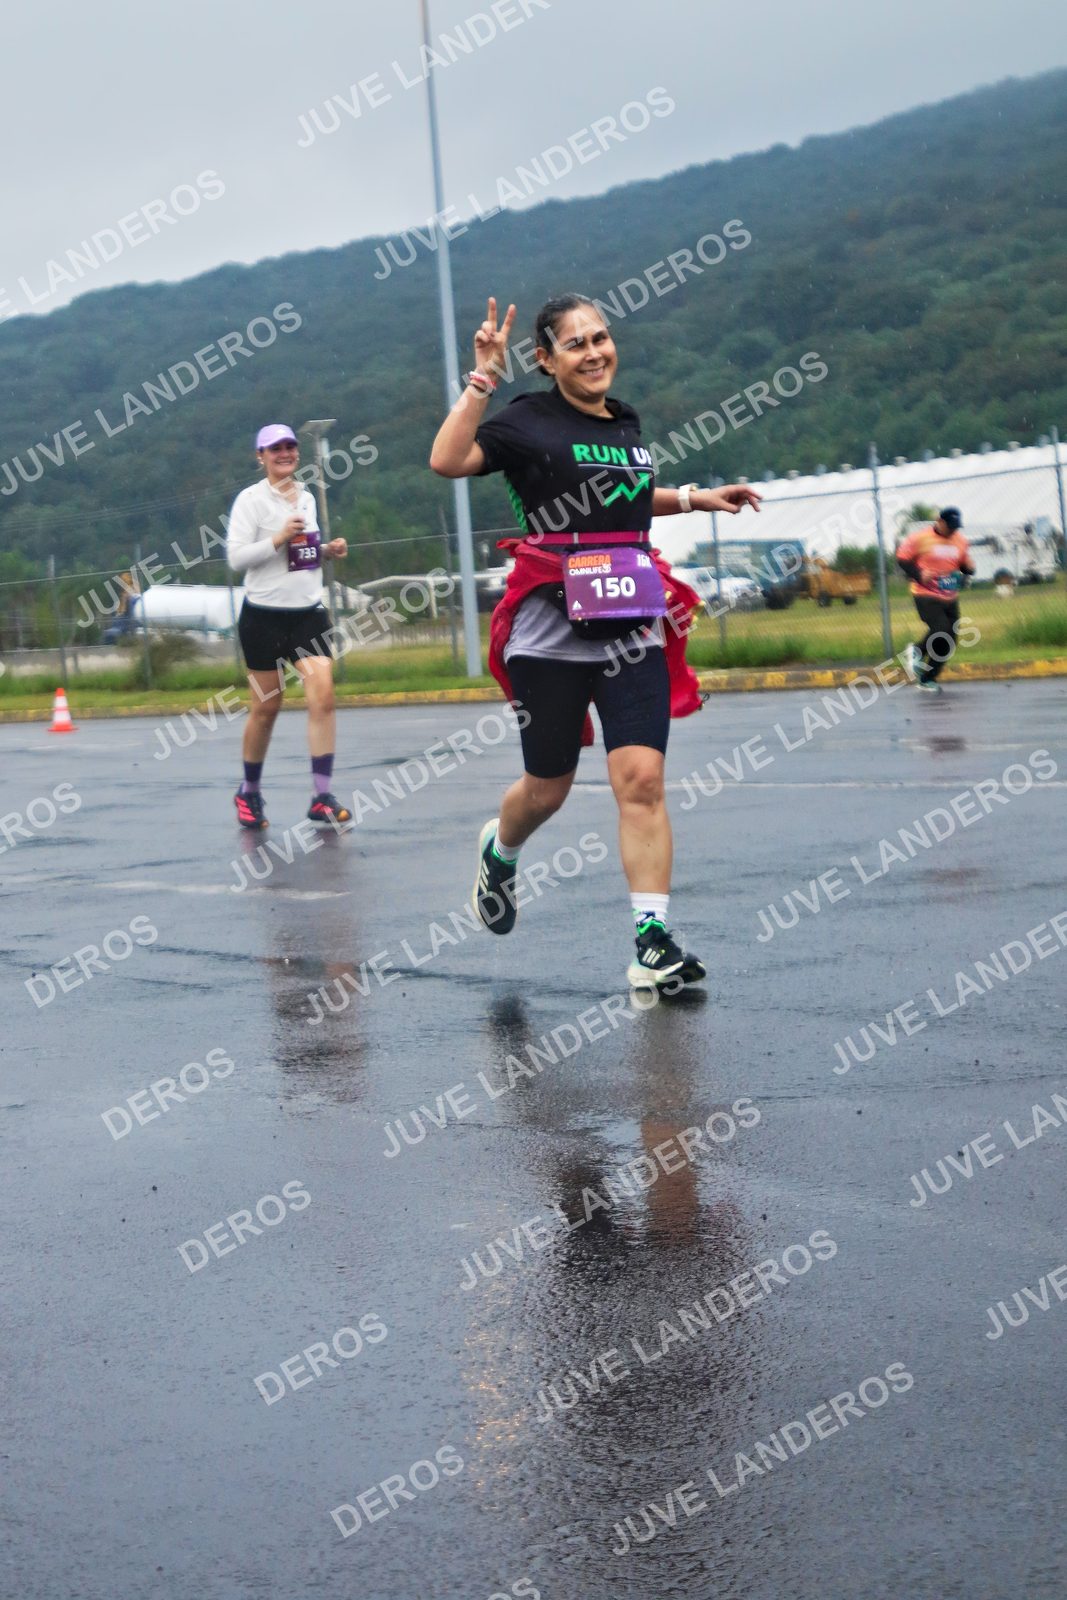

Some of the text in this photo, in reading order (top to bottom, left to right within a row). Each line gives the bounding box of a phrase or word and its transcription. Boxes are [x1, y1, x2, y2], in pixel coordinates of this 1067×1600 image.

[572, 444, 629, 464] RUN
[298, 546, 317, 560] 733
[568, 554, 611, 568] CARRERA
[590, 576, 636, 598] 150
